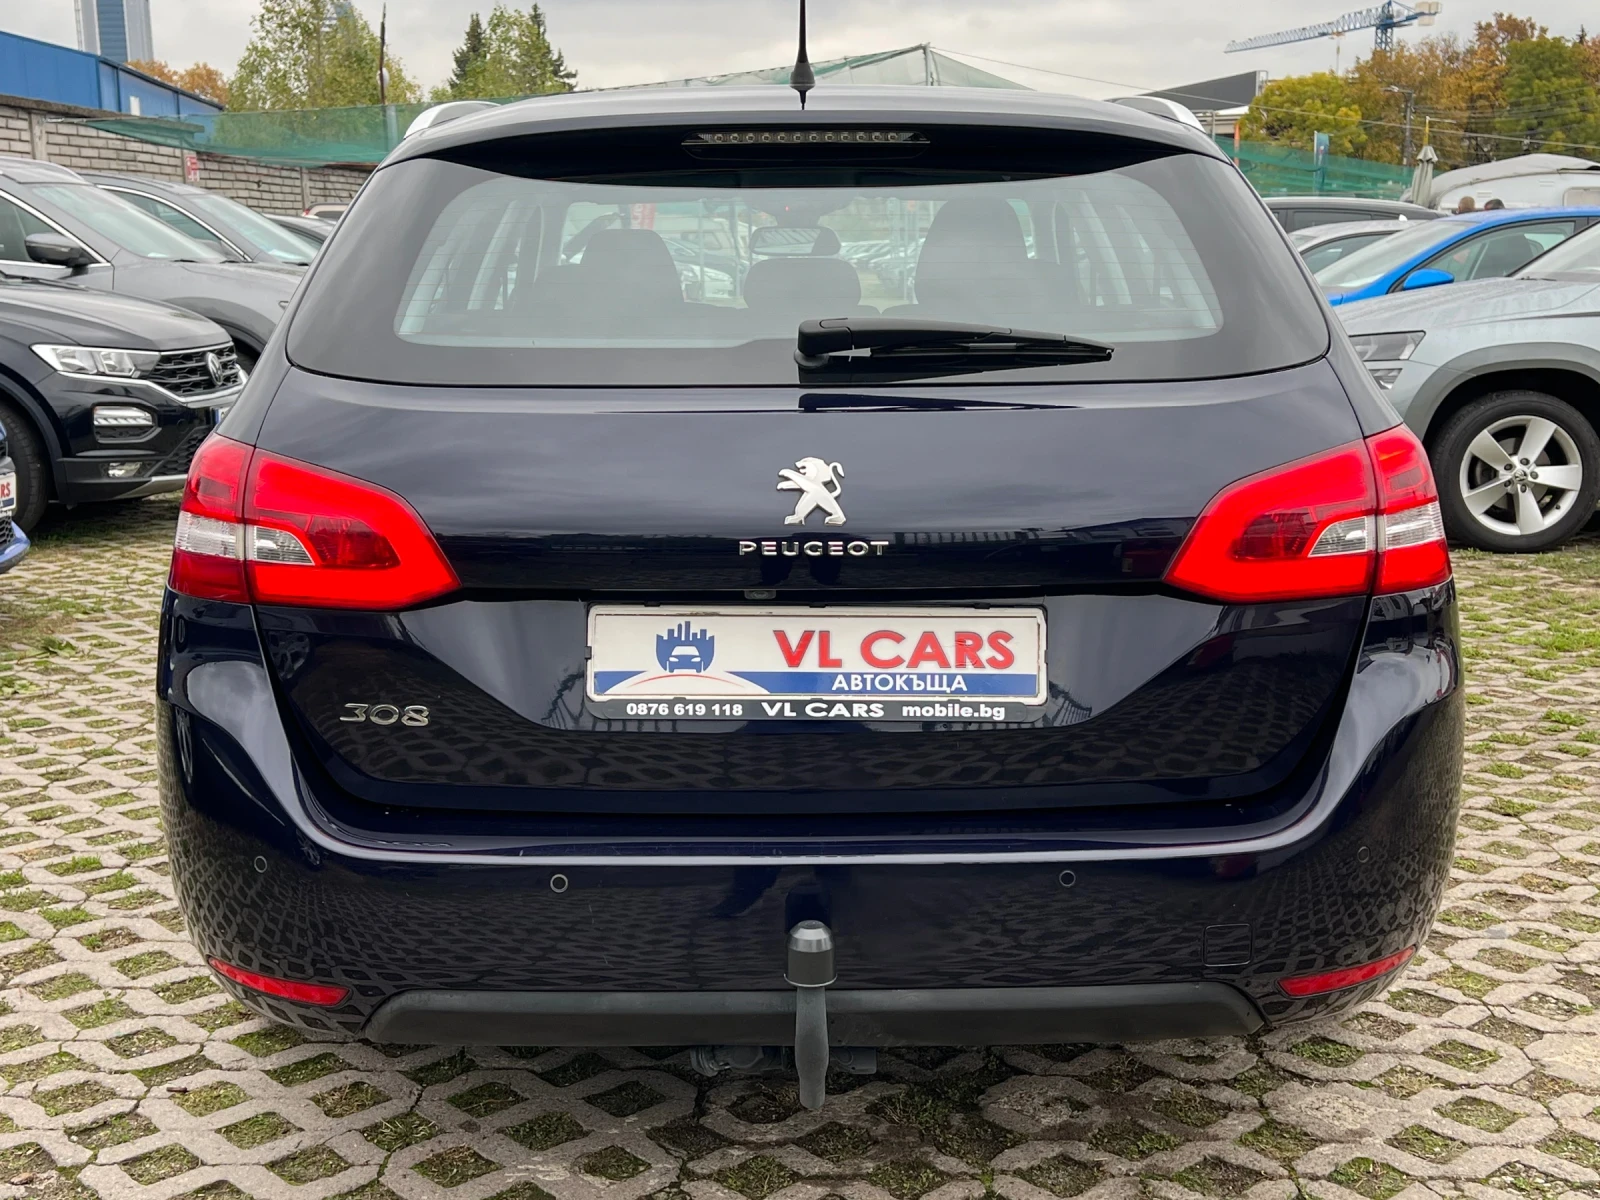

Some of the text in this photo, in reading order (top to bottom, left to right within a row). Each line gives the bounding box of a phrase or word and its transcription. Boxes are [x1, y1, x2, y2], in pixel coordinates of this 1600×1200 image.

[738, 540, 889, 556] PEUGEOT
[773, 630, 1015, 669] VL CARS
[832, 674, 968, 693] АВТОКЪЩА
[339, 702, 430, 727] 308
[626, 702, 1006, 720] 0876 619 118 VL CARS mobile.bg
